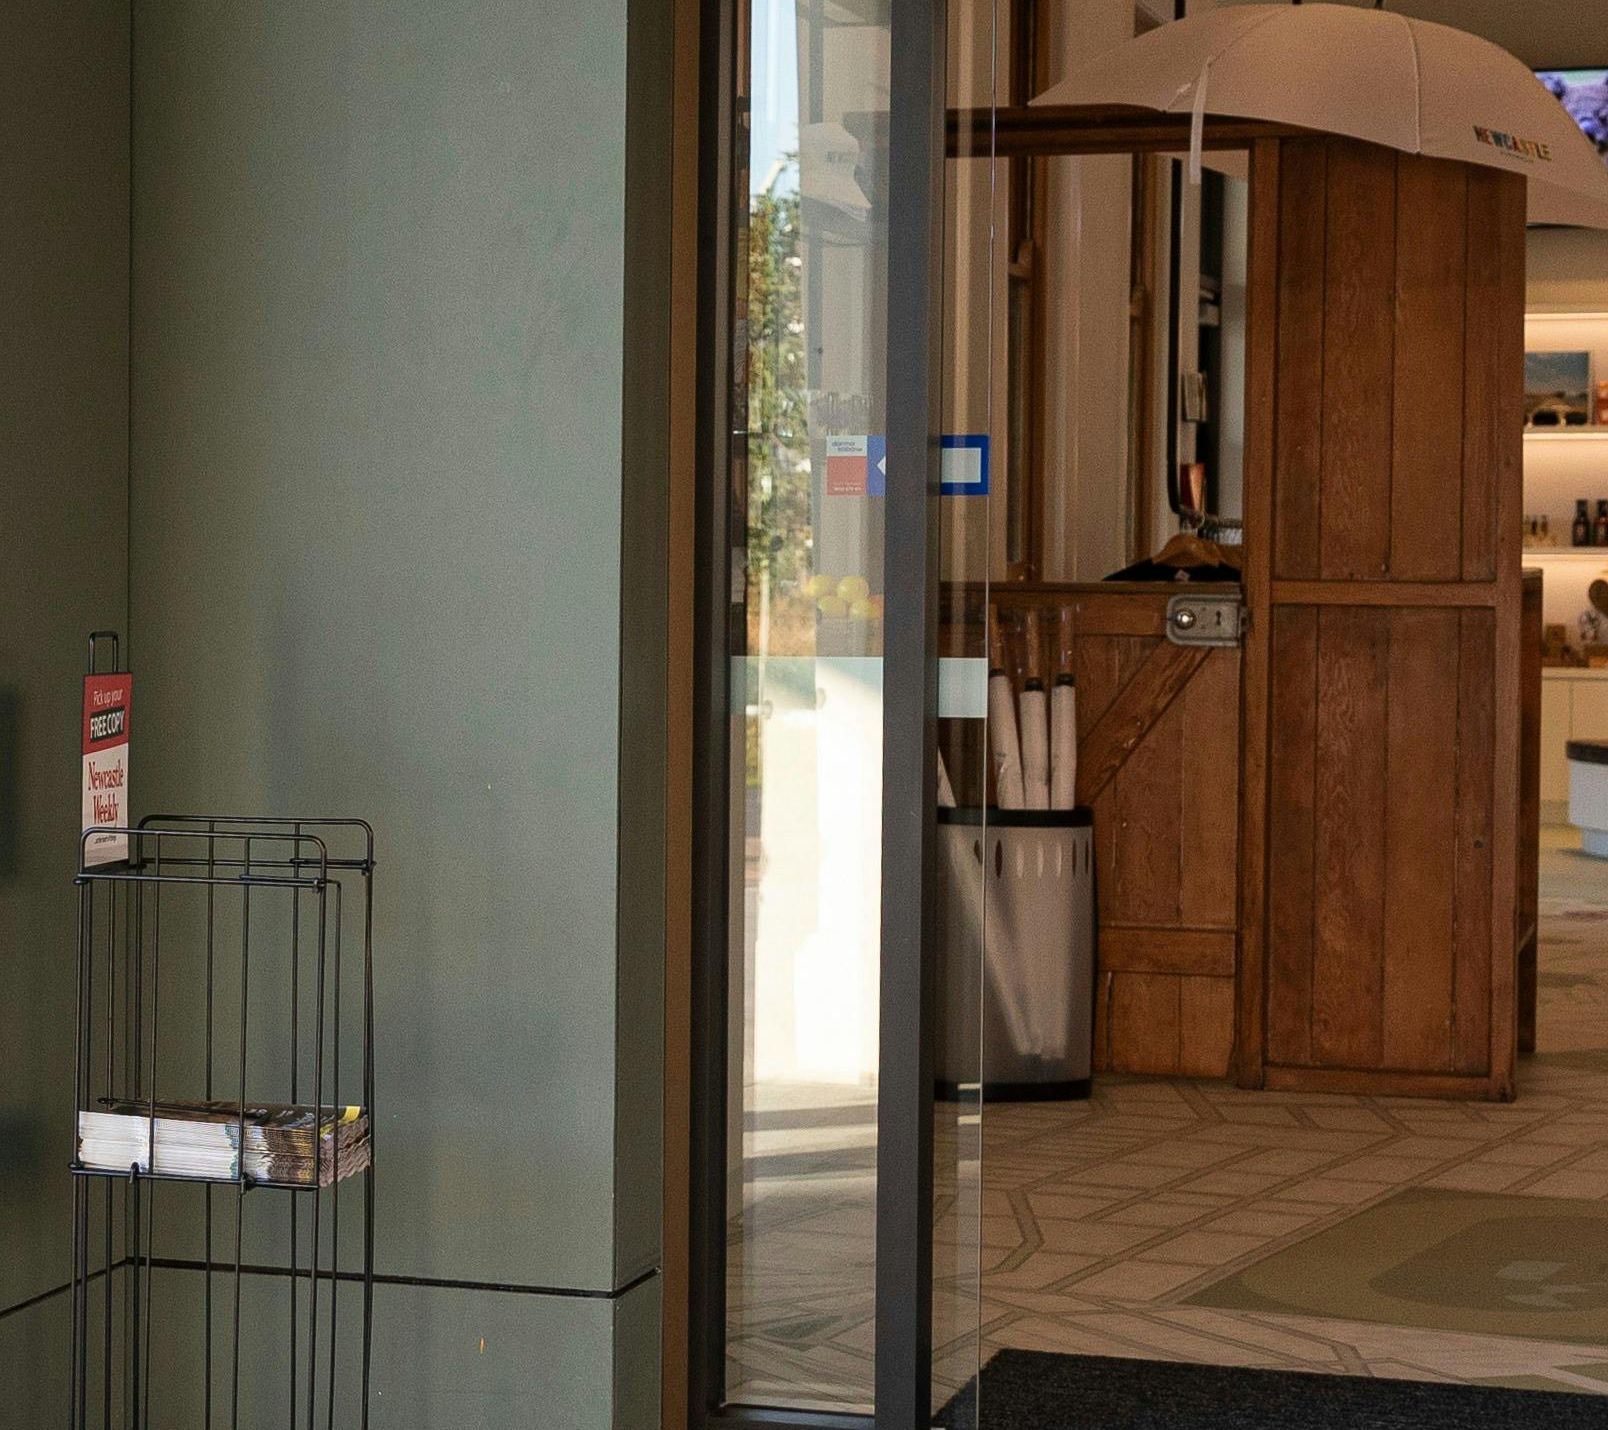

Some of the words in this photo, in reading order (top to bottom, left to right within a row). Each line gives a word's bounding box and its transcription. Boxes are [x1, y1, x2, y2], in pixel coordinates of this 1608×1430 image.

[93, 690, 104, 707] Pick
[111, 689, 124, 706] your
[90, 715, 106, 740] FREE
[106, 710, 125, 735] COPY
[88, 758, 124, 791] Newcastle
[93, 792, 120, 829] Weekly
